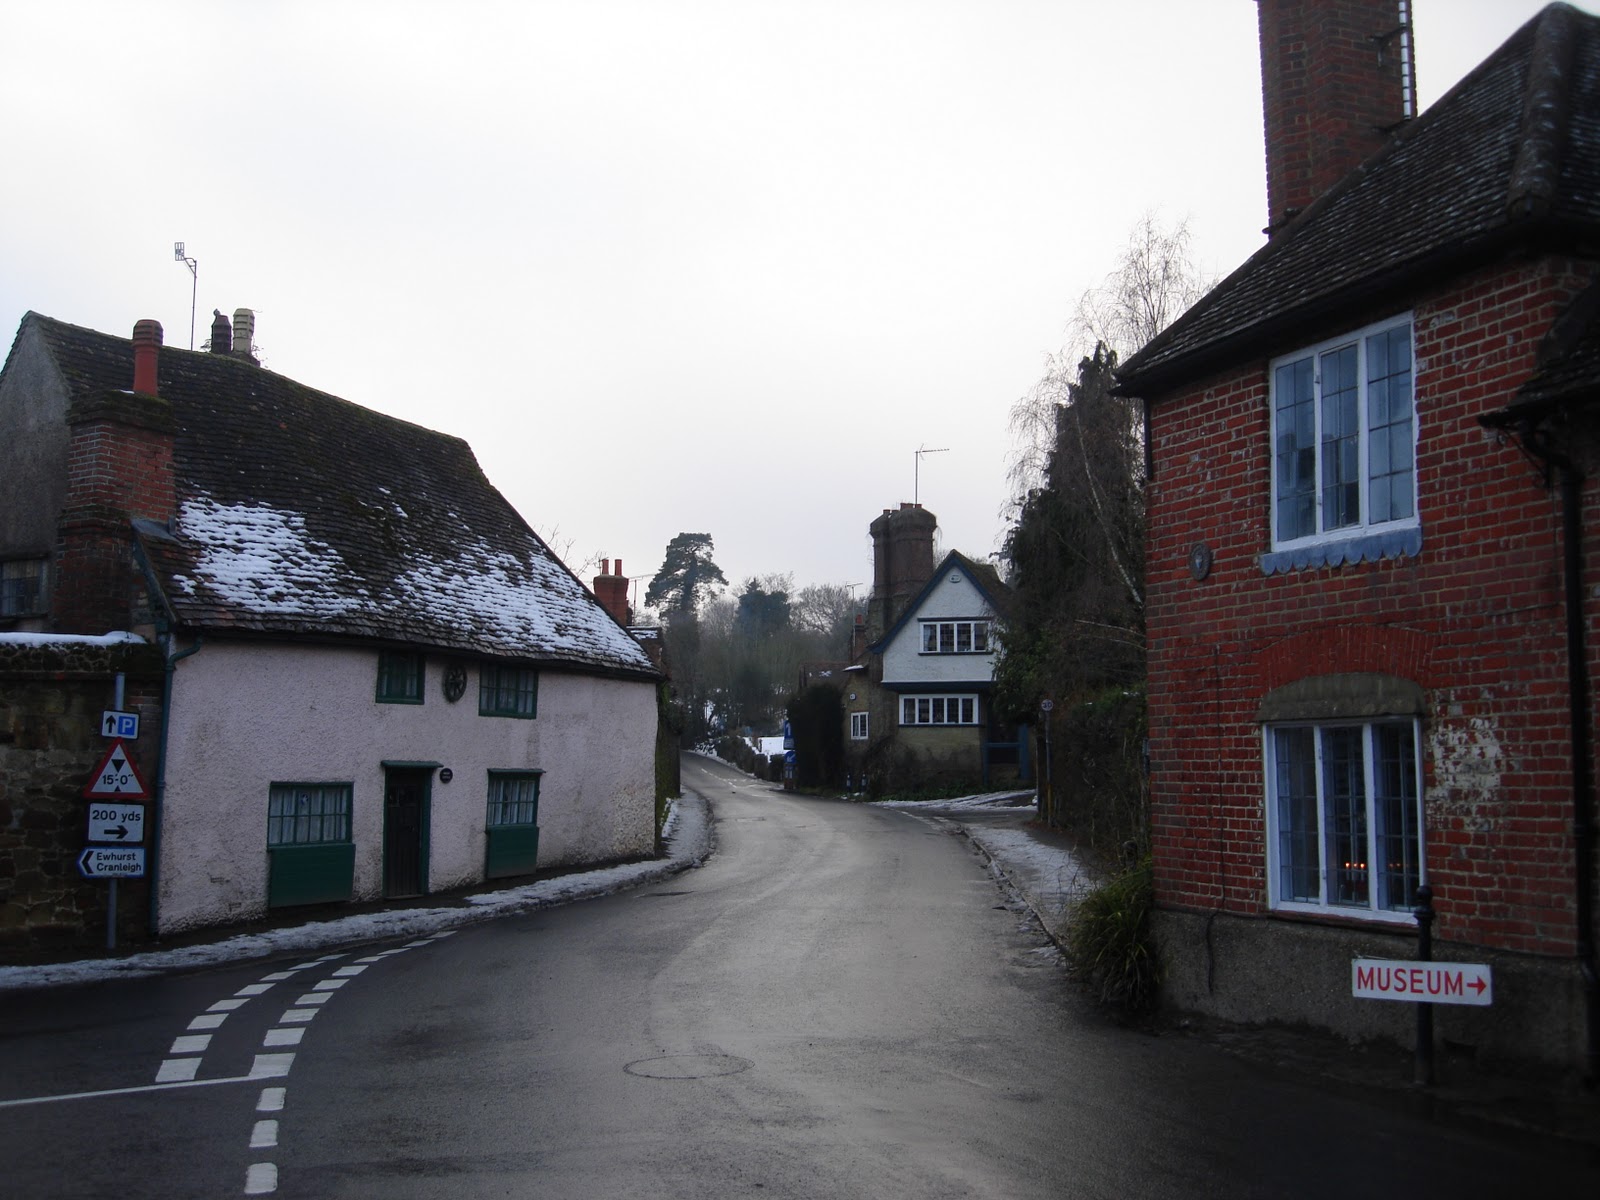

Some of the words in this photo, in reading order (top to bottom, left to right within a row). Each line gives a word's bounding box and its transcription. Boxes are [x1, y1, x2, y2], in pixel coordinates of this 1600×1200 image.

[121, 718, 133, 734] P
[92, 810, 117, 821] 200
[121, 811, 141, 823] yds
[96, 852, 136, 861] Ewhurst
[96, 862, 142, 873] Cranleigh
[1357, 966, 1464, 996] MUSEUM
